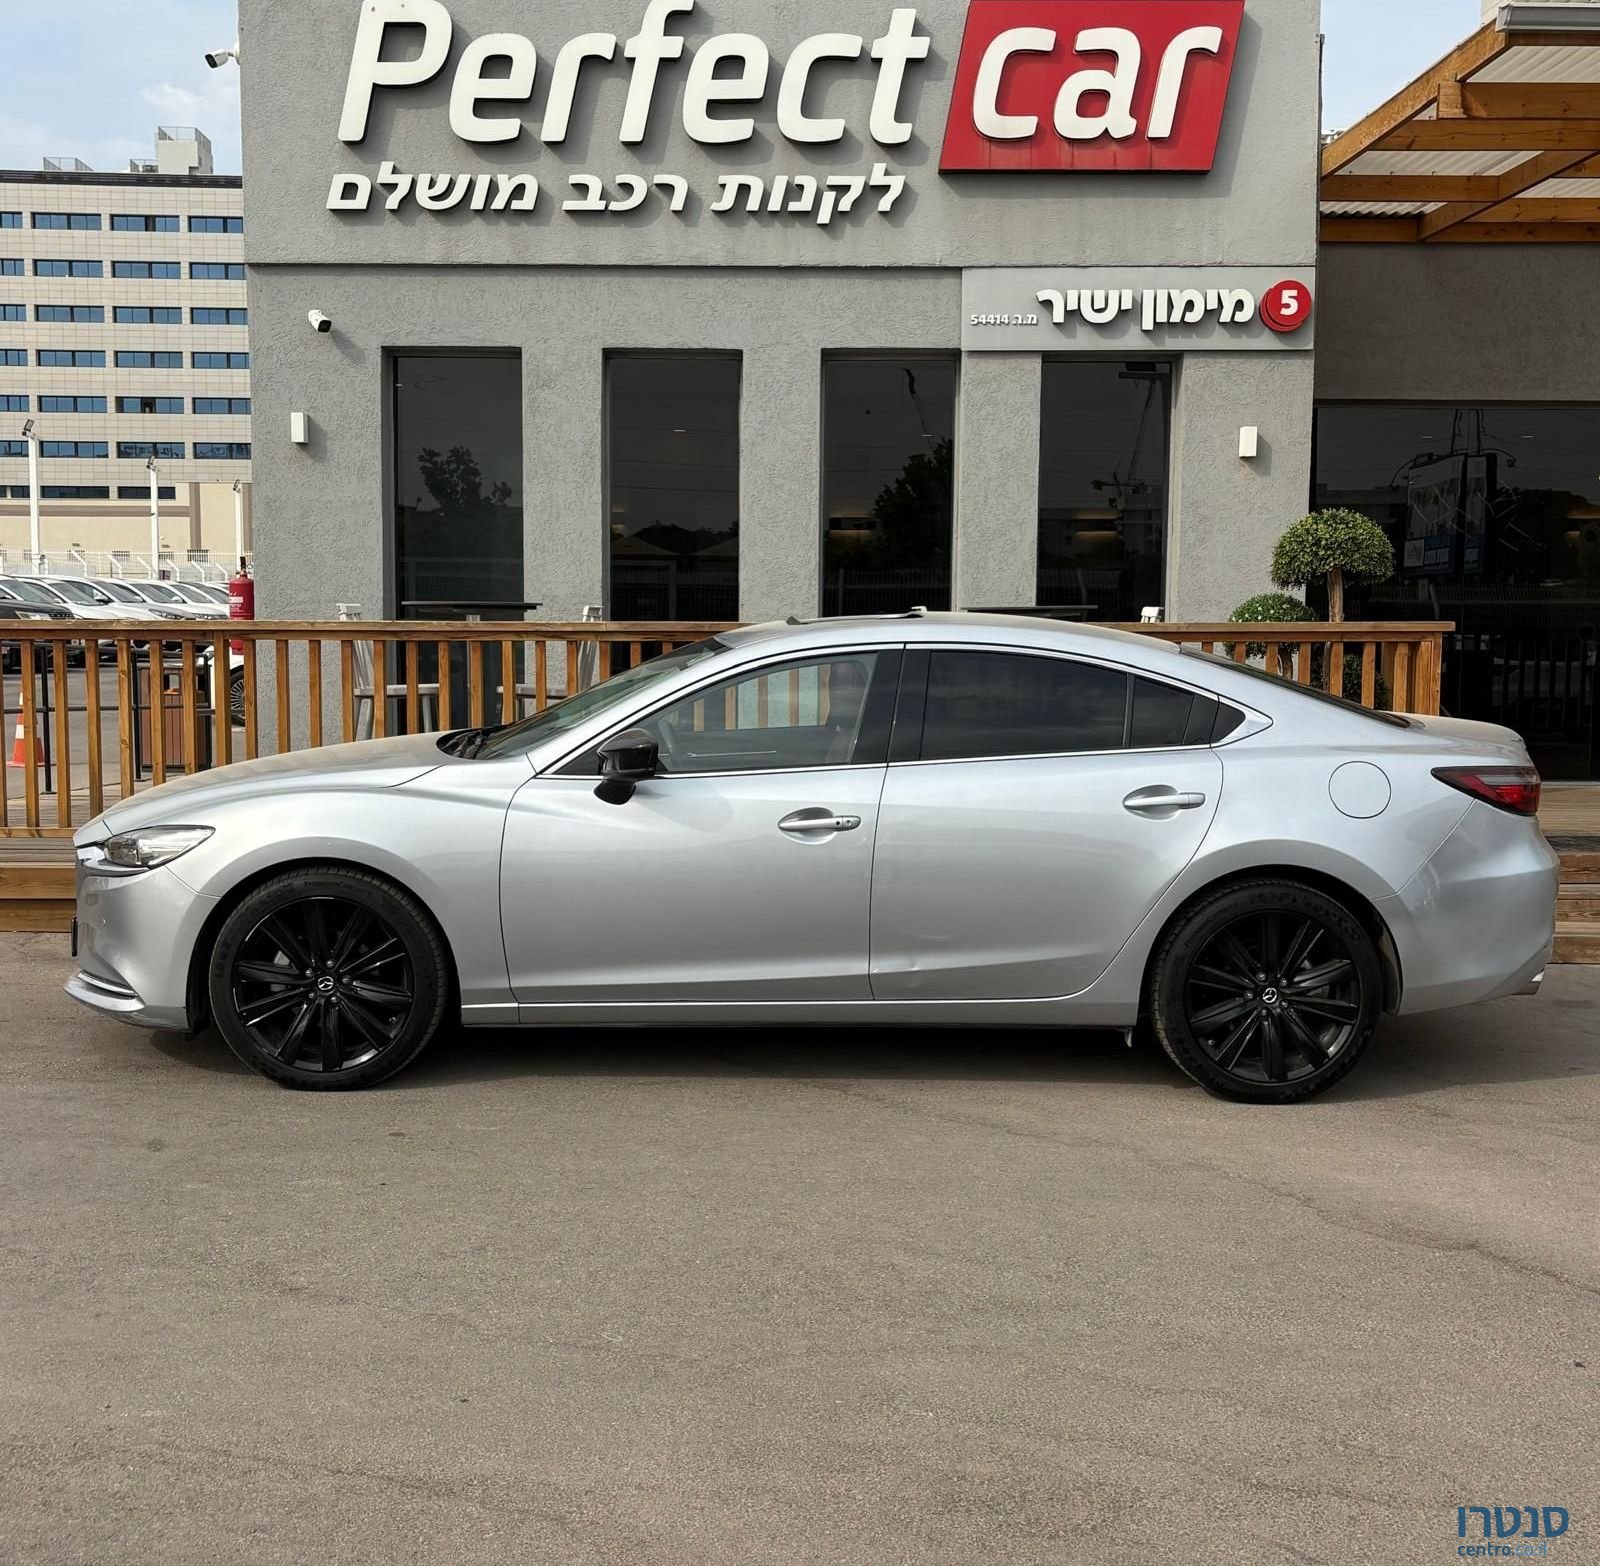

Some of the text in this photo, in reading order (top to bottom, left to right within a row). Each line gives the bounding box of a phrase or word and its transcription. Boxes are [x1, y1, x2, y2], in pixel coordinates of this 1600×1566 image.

[337, 0, 1223, 145] Perfect car
[325, 161, 906, 224] לקנות רכב מושלם
[970, 313, 1010, 325] 54414
[1036, 288, 1256, 331] מימון ישיר
[1279, 289, 1299, 316] 5
